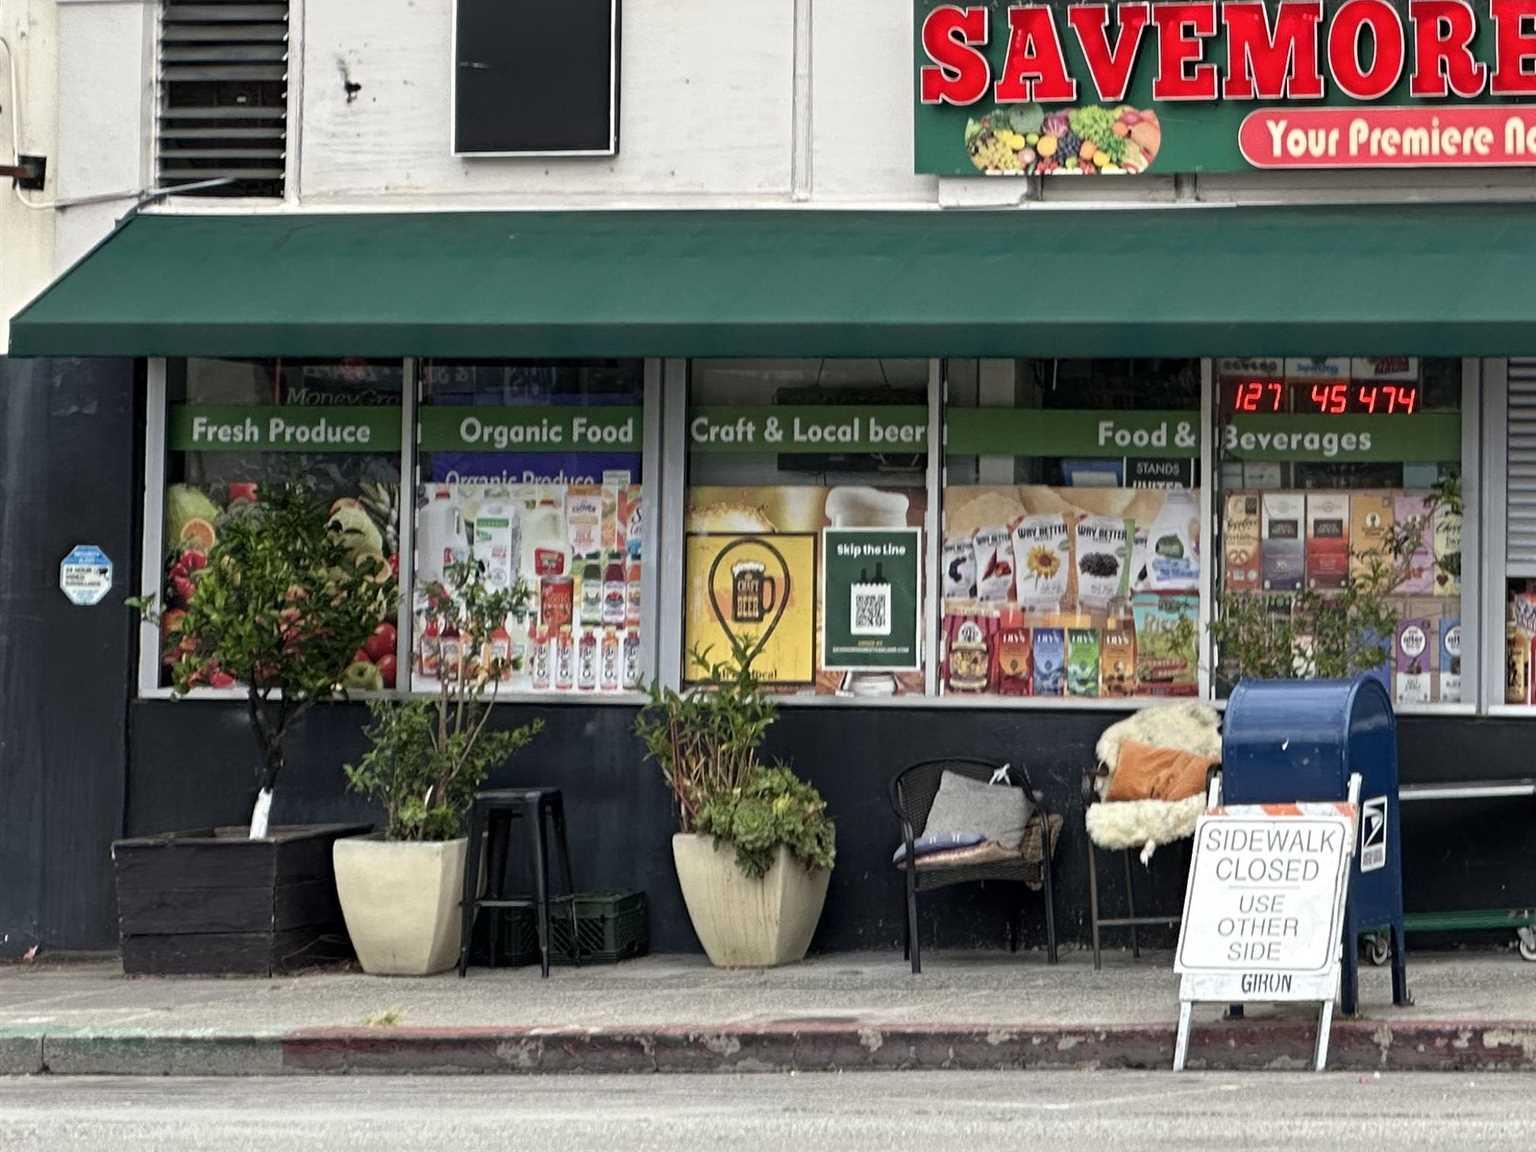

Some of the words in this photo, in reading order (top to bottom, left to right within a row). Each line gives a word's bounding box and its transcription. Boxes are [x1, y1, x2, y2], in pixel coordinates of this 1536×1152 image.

[1266, 119, 1339, 158] Your
[1350, 116, 1494, 157] Premiere
[1235, 382, 1281, 411] 127
[1311, 384, 1347, 413] 45
[1359, 385, 1415, 414] 474
[192, 416, 259, 442] Fresh
[269, 417, 370, 442] Produce
[460, 416, 562, 448] Organic
[572, 417, 633, 443] Food
[691, 416, 755, 442] Craft
[764, 416, 783, 442] &
[794, 417, 859, 442] Local
[869, 417, 926, 442] beer
[1099, 421, 1167, 447] Food
[1174, 421, 1196, 447] &
[1224, 425, 1371, 456] Beverages
[1136, 462, 1180, 475] STANDS
[837, 542, 862, 559] Skip
[863, 543, 881, 556] the
[883, 541, 907, 556] Line
[1206, 829, 1336, 853] SIDEWALK
[1216, 858, 1319, 882] CLOSED
[1239, 894, 1286, 914] USE
[1217, 917, 1299, 938] OTHER
[1227, 942, 1281, 962] SIDE
[1241, 973, 1292, 993] GIRON
